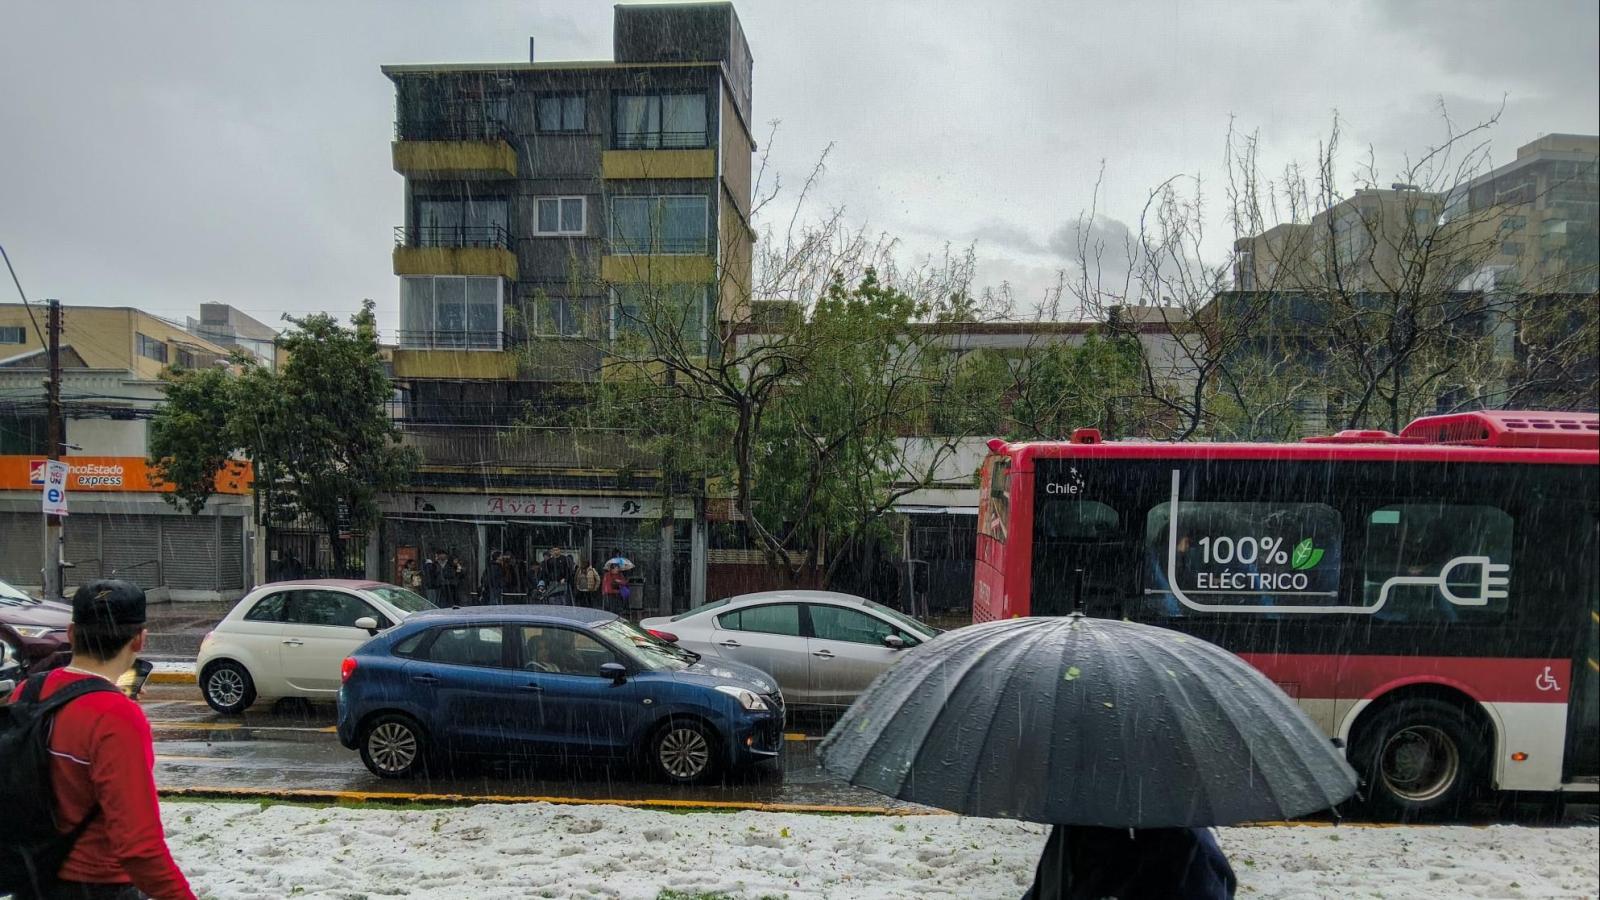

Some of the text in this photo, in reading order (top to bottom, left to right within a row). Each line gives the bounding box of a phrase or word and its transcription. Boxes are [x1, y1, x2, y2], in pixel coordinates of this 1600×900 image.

[68, 463, 124, 475] ncoEstado
[78, 475, 122, 487] express
[1046, 482, 1078, 494] Chile
[487, 497, 580, 516] Avatte
[1198, 536, 1288, 565] 100%
[1196, 568, 1308, 590] ELÉCTRICO
